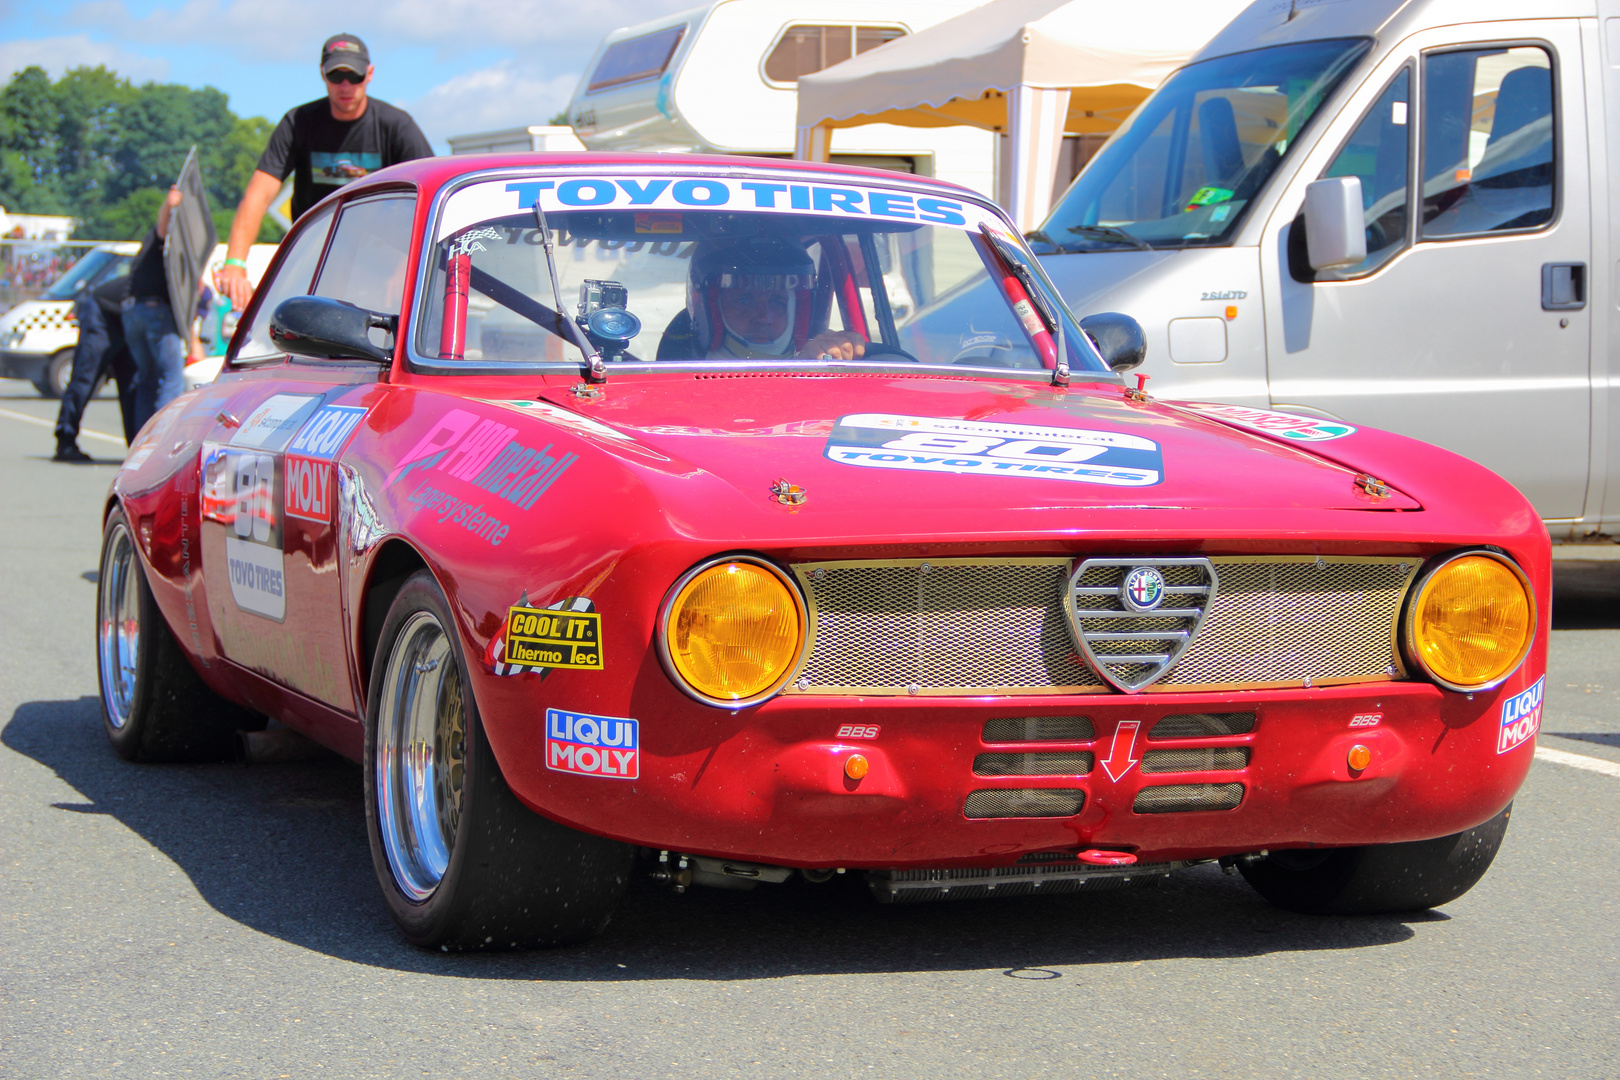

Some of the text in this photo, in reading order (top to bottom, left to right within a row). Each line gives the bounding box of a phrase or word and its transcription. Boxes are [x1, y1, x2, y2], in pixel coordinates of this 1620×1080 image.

[505, 179, 967, 226] TOYO TIRES
[291, 409, 362, 455] LIQUI
[881, 432, 1109, 463] 80
[839, 451, 1148, 481] TOYO TIRES
[286, 458, 330, 515] MOLY
[407, 478, 510, 546] Lagersysteme
[229, 558, 283, 598] TOYO TIRES
[1129, 571, 1162, 590] ALFA ROMEO
[511, 613, 561, 638] COOL
[510, 637, 597, 664] Thermo Tec
[1504, 679, 1544, 724] LIQUI
[551, 712, 633, 747] LIQUI
[836, 725, 879, 738] BBS
[1349, 714, 1382, 727] BBS
[1501, 703, 1542, 749] MOLY
[551, 742, 636, 775] MOLY
